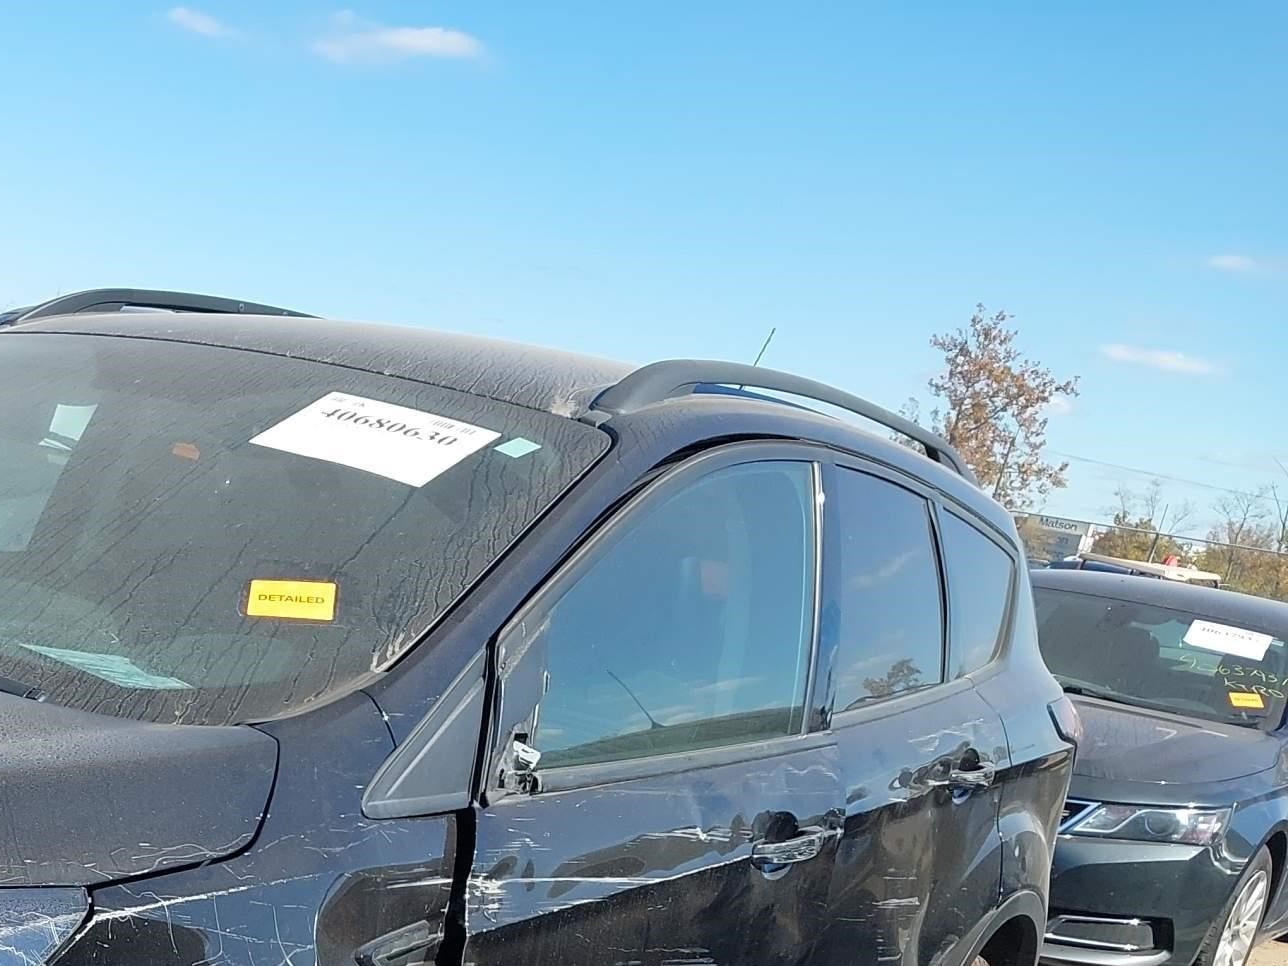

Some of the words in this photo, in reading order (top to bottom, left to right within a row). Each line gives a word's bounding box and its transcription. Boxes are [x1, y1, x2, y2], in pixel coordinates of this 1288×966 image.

[320, 407, 459, 447] 40680630
[1038, 515, 1078, 532] Matson
[258, 594, 325, 604] DETAILED
